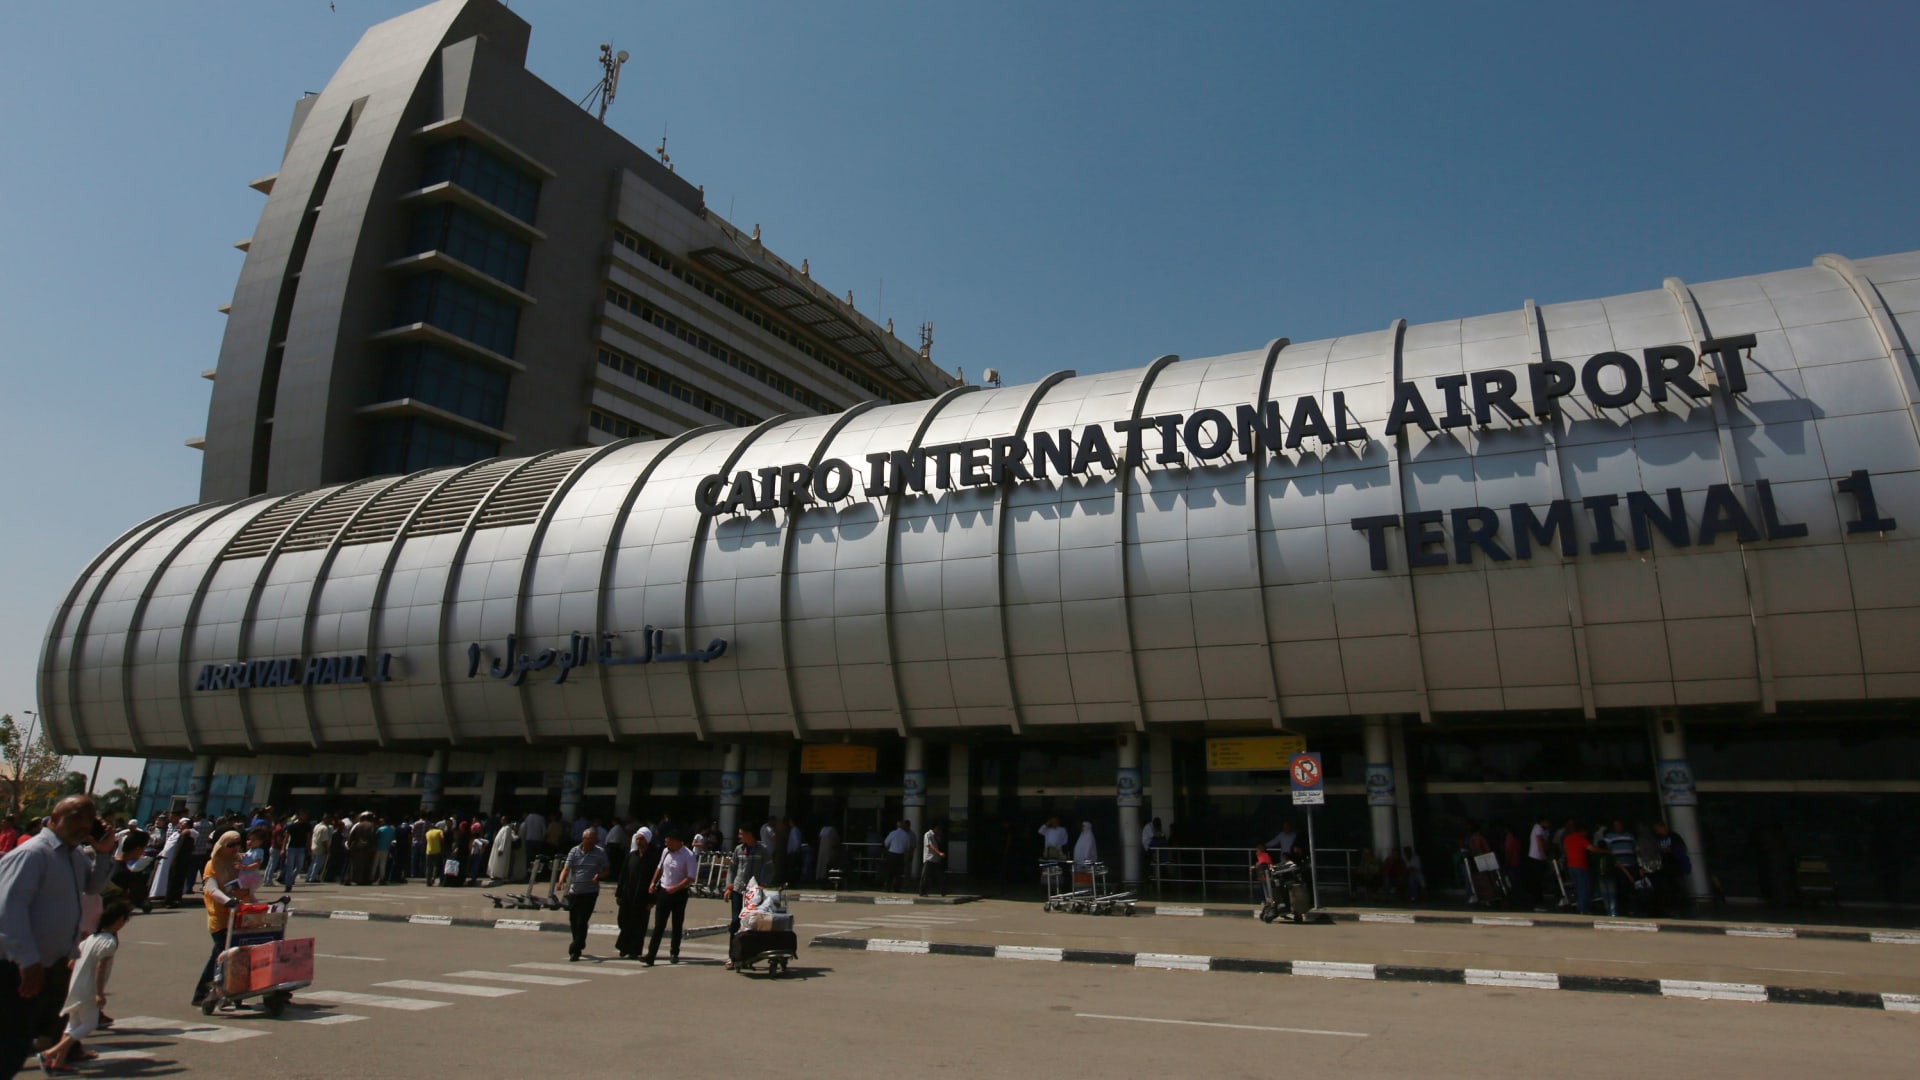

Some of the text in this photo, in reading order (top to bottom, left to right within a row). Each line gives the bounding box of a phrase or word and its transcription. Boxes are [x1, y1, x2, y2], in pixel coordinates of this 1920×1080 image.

[695, 333, 1758, 516] CAIRO INTERNATIONAL AIRPORT
[1351, 469, 1897, 571] TERMINAL 1
[194, 653, 392, 691] ARRIVAL HALL 1
[491, 631, 589, 685] الوصول
